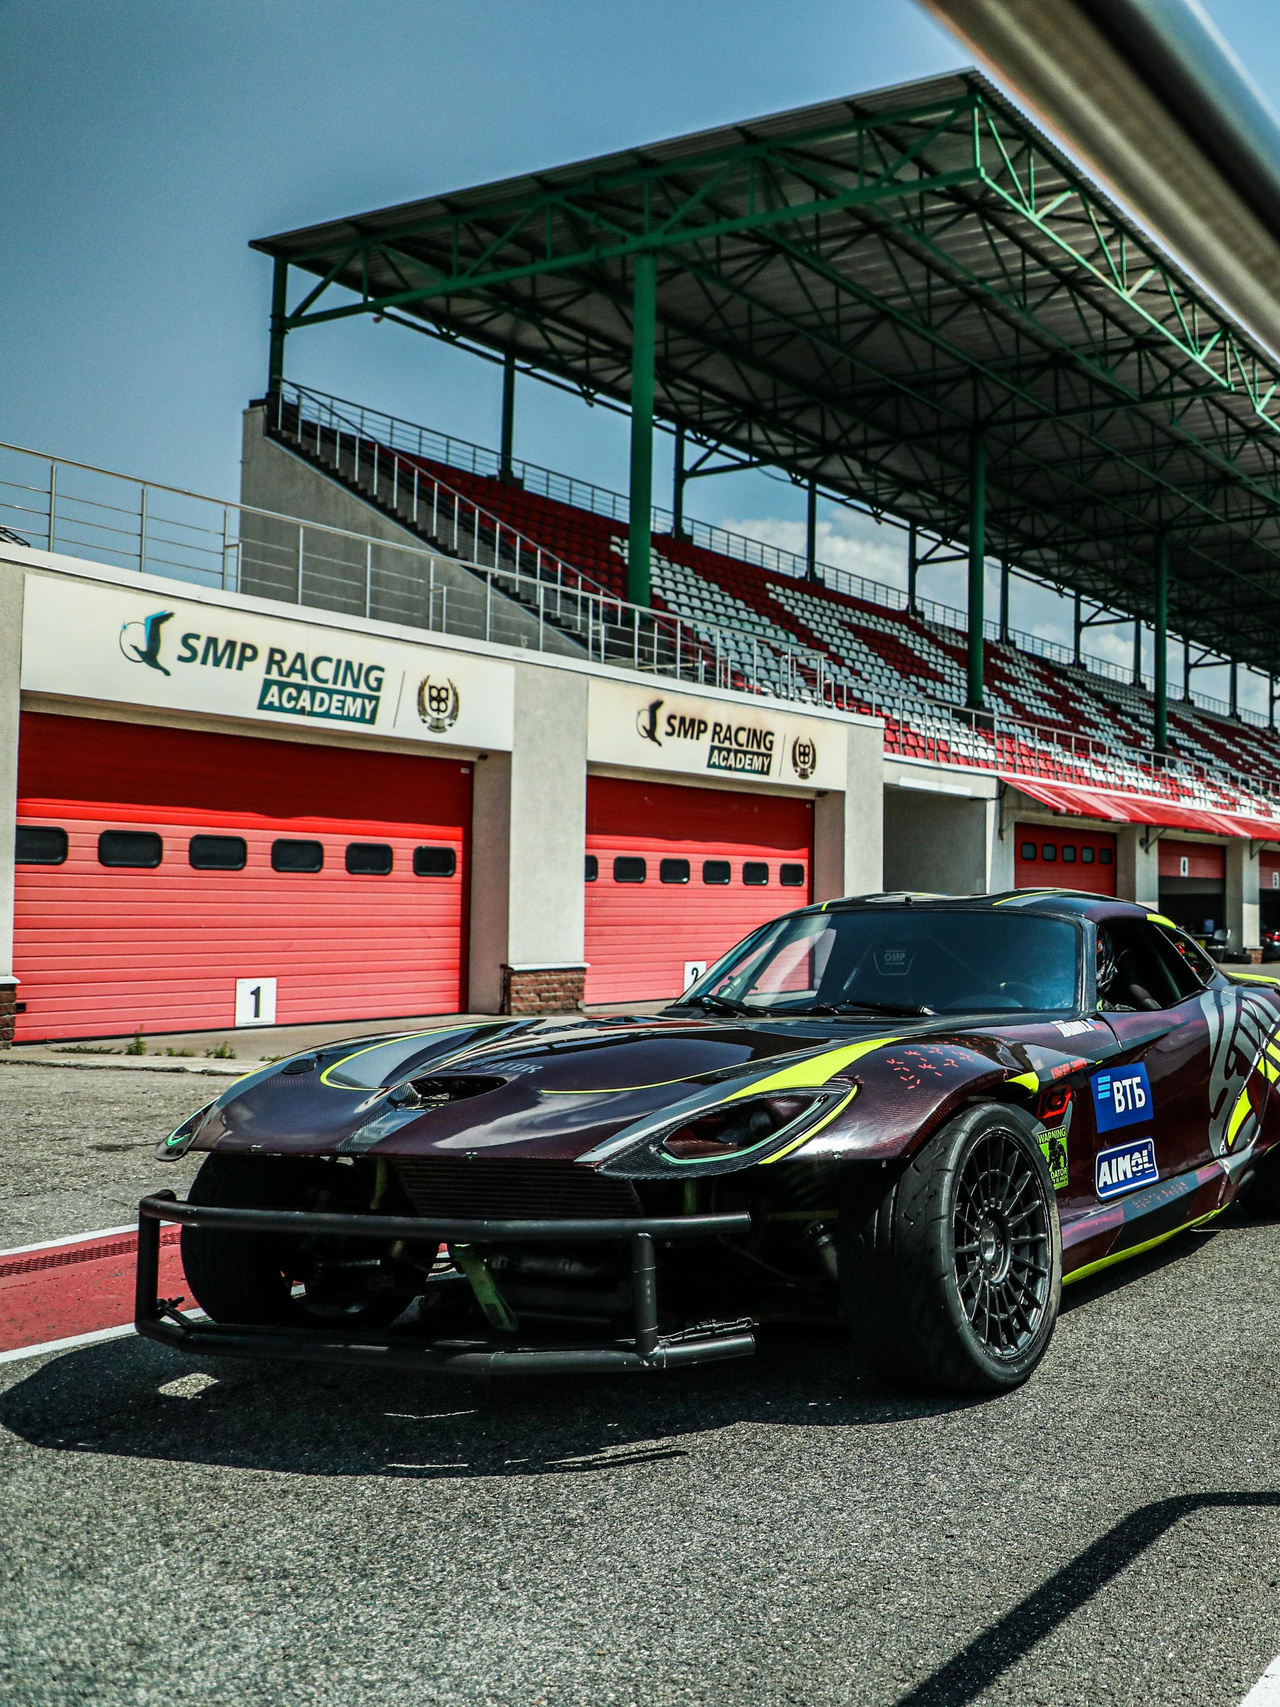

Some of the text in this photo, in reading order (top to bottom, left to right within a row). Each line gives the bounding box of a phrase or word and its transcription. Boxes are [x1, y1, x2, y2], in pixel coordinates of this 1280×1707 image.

[176, 632, 386, 693] SMP RACING
[262, 684, 377, 720] ACADEMY
[665, 714, 775, 752] SMP RACING
[709, 748, 771, 773] ACADEMY
[884, 952, 906, 962] OMP
[250, 985, 261, 1018] 1
[1112, 1076, 1146, 1114] ВТБ
[1037, 1127, 1067, 1143] WARNING
[1050, 1167, 1068, 1179] DATOR
[1098, 1149, 1155, 1188] AIMOL
